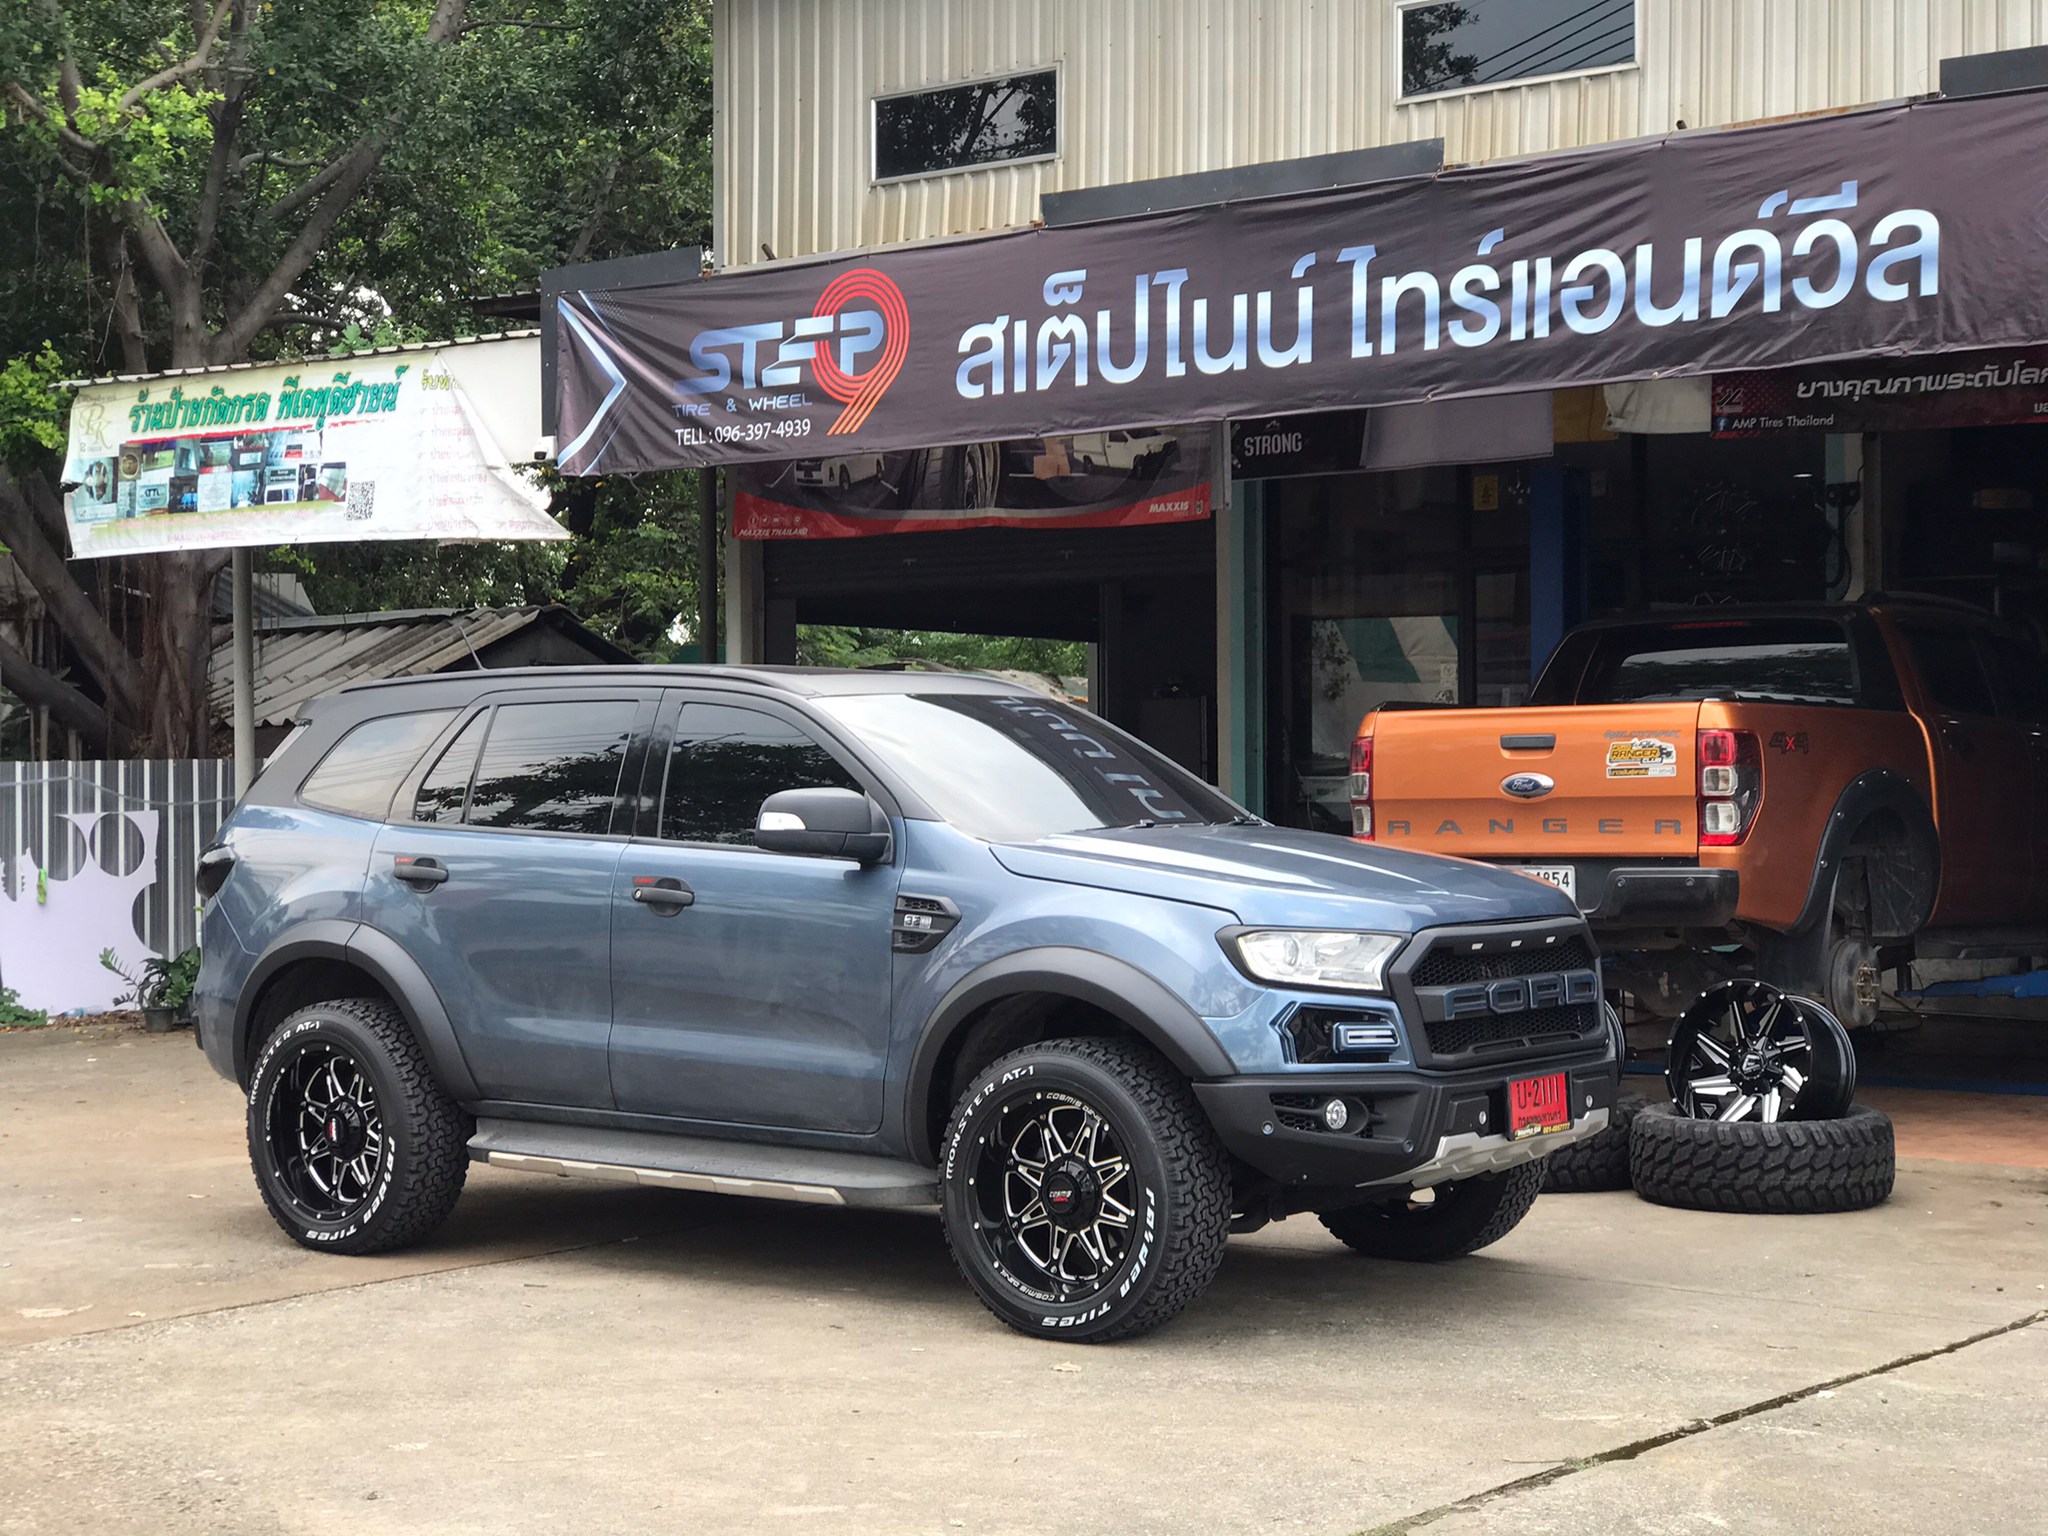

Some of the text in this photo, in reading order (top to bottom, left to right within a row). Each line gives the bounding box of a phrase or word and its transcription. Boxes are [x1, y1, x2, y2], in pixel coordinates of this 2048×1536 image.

[955, 180, 1940, 399] สเต็ปไนน์ ไทร์แอนด์วีล
[672, 393, 813, 417] TIRE & WHEEL
[1731, 414, 1834, 429] AMP Tires Thailand
[715, 418, 811, 443] 096-397-4939
[1244, 432, 1302, 457] STRONG
[1149, 500, 1189, 513] MAXXIS
[739, 527, 809, 537] MAXXIS THAILAND
[1611, 748, 1659, 759] RANGER
[1512, 778, 1535, 790] Ford
[1388, 818, 1681, 835] RANGER
[1444, 971, 1598, 1021] FORD
[296, 1021, 320, 1033] AT-1
[946, 1065, 1034, 1180] MONSTER AT-1
